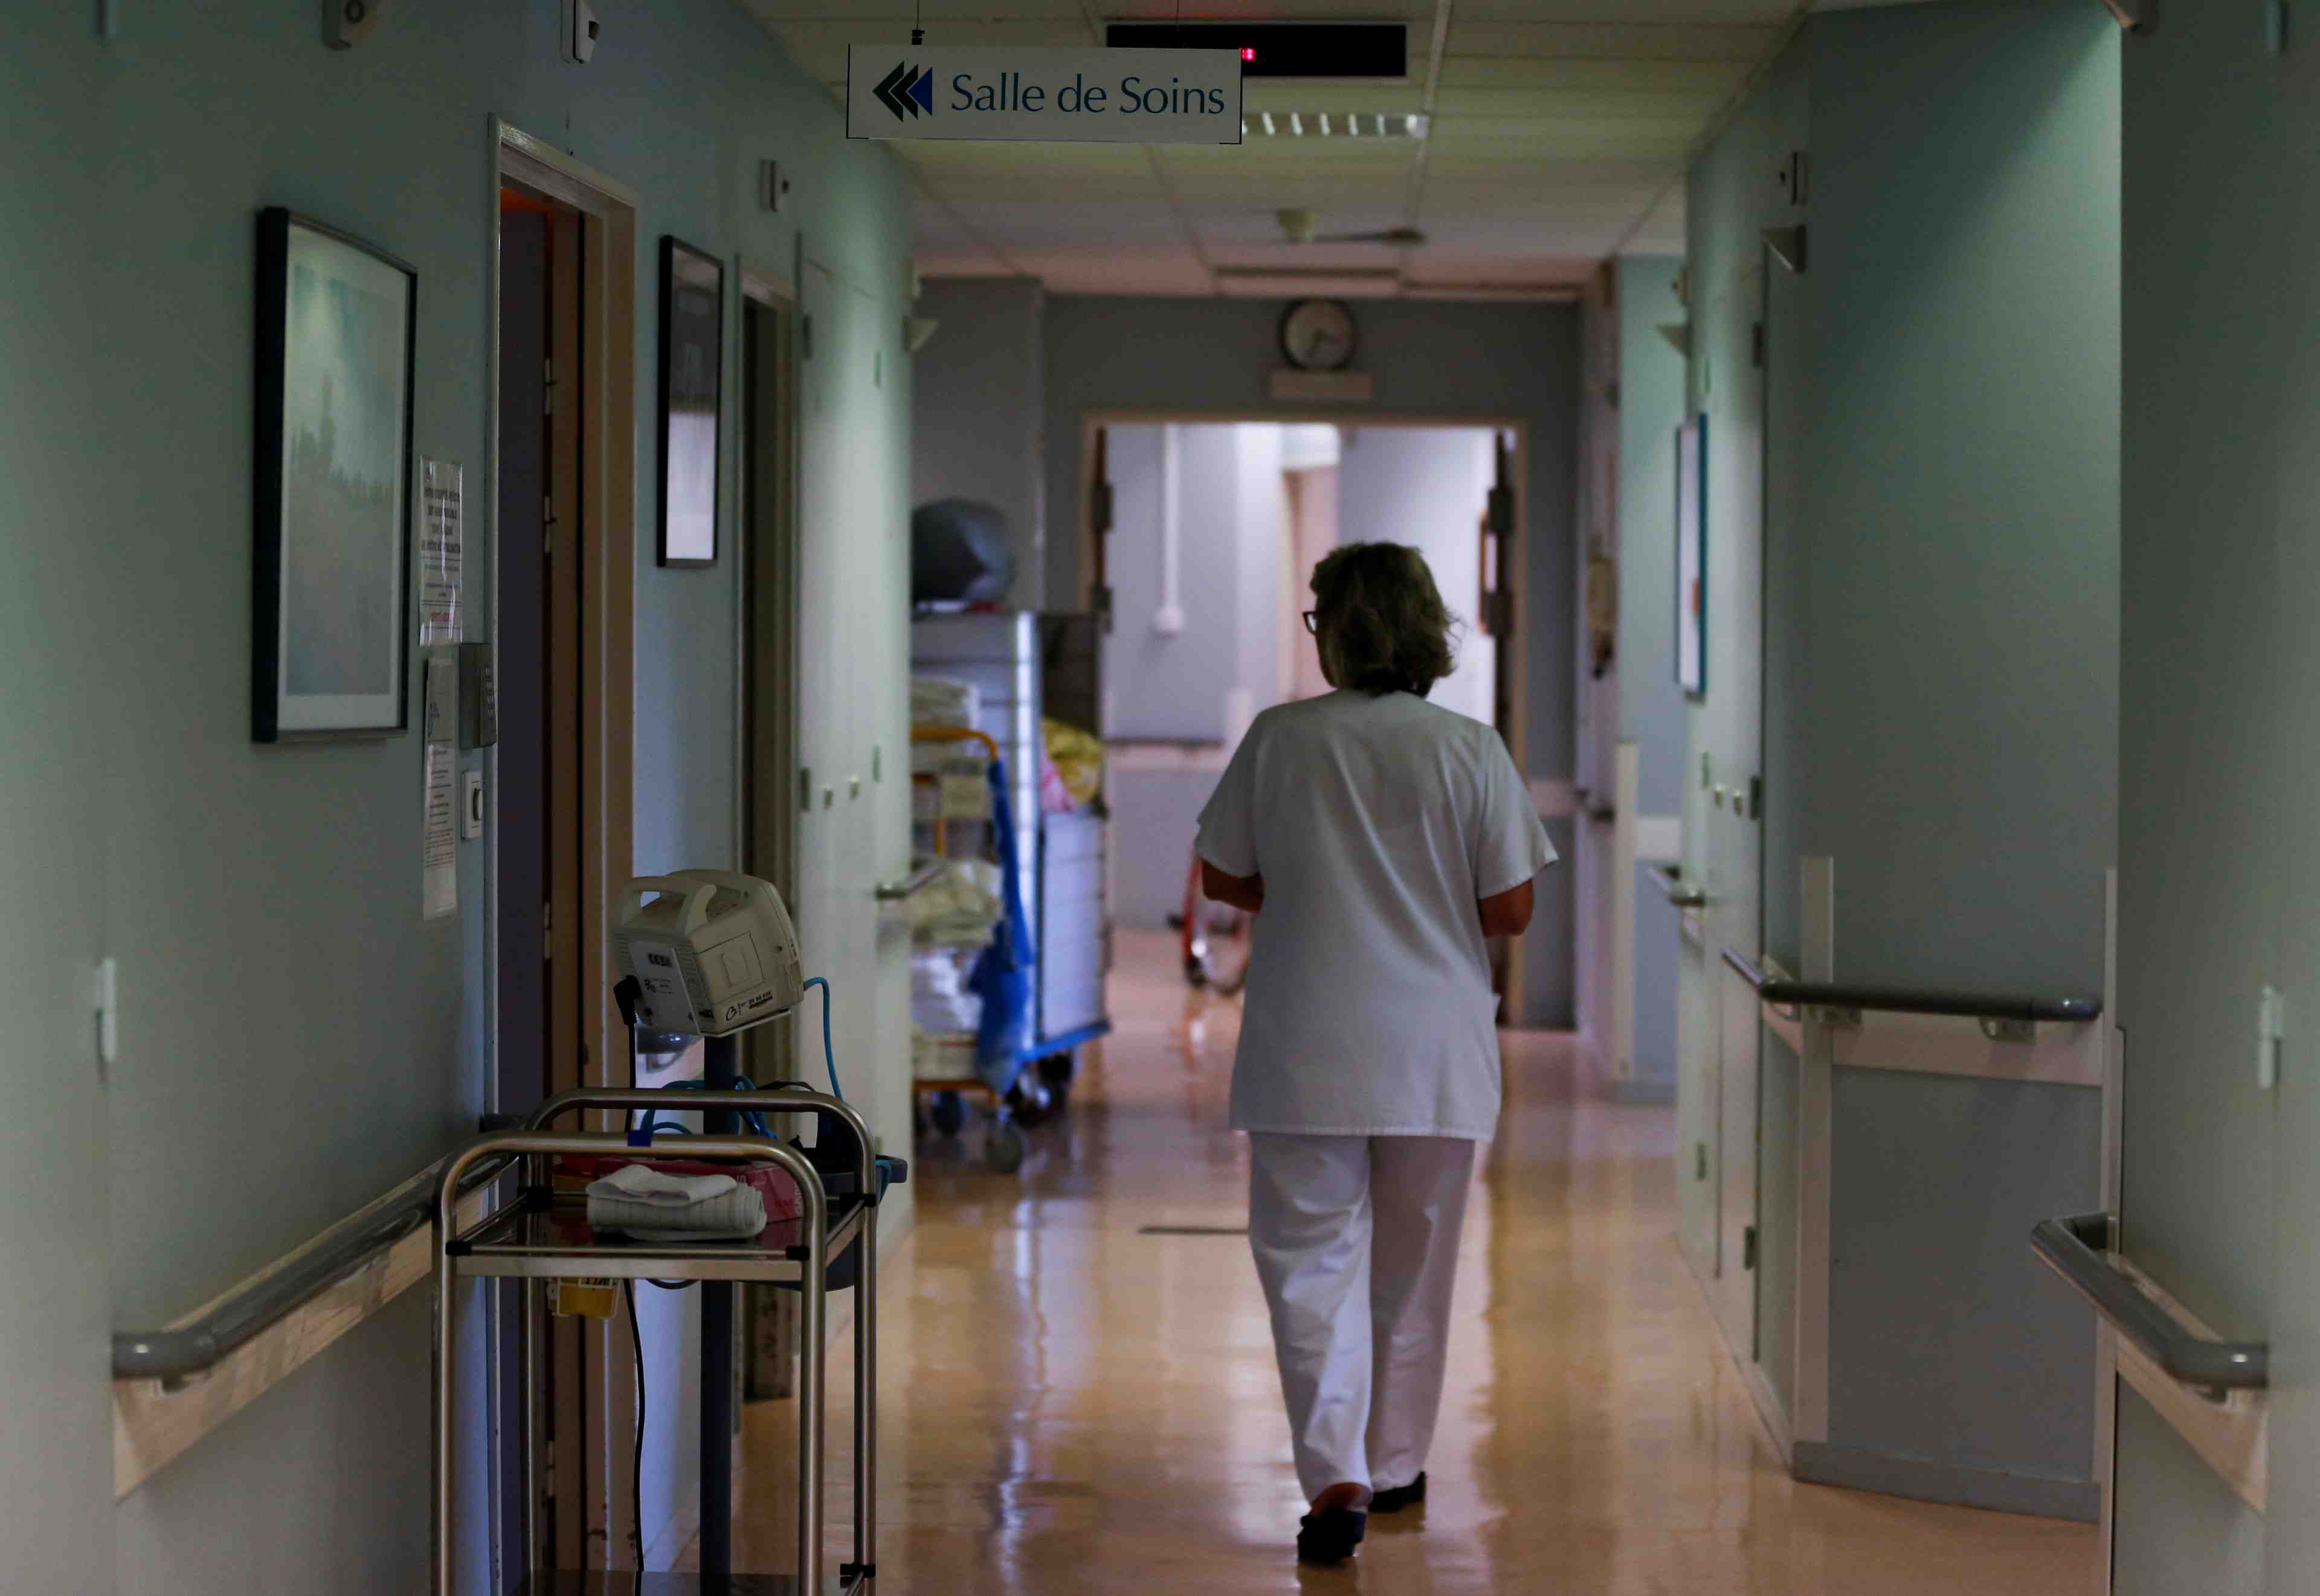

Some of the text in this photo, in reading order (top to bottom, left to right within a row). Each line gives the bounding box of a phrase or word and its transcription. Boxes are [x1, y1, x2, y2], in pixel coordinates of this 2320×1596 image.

[951, 72, 1225, 115] Salle de Soins
